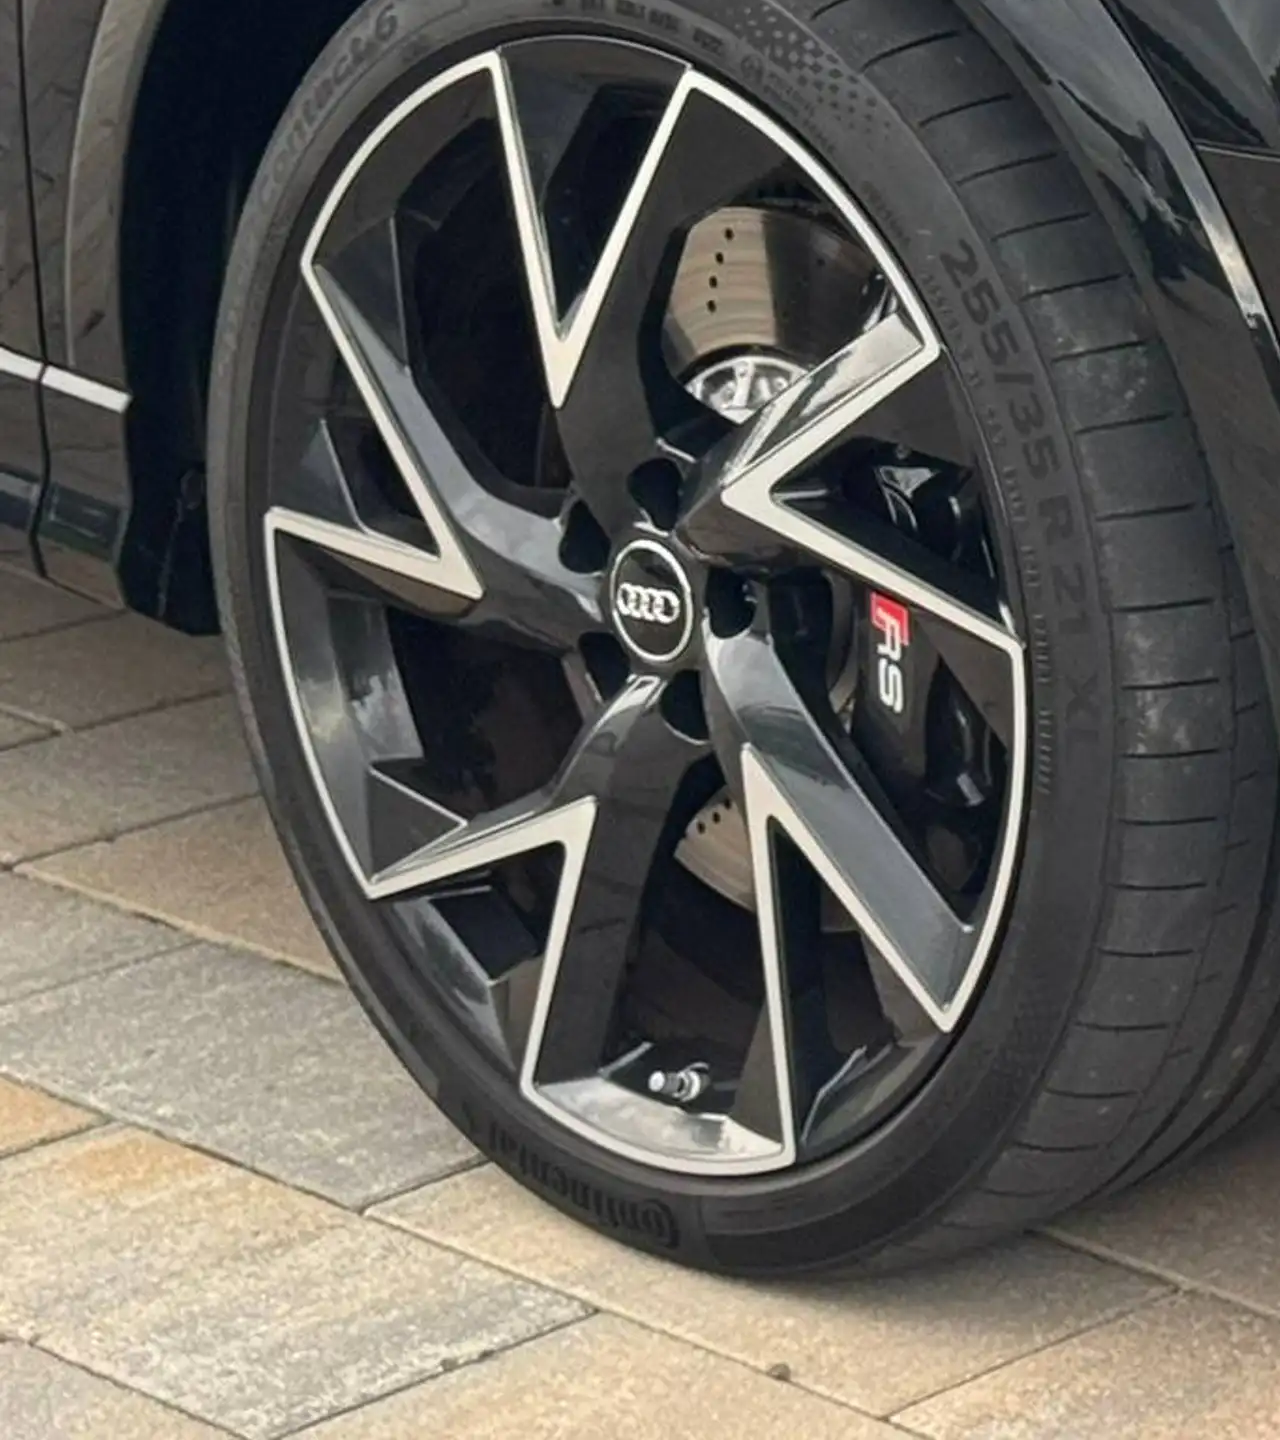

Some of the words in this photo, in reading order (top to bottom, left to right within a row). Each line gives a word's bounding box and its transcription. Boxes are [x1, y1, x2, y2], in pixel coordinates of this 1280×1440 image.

[938, 237, 1063, 481] 255/35
[1036, 493, 1076, 547] R
[1051, 564, 1092, 634] 21
[873, 598, 906, 714] RS
